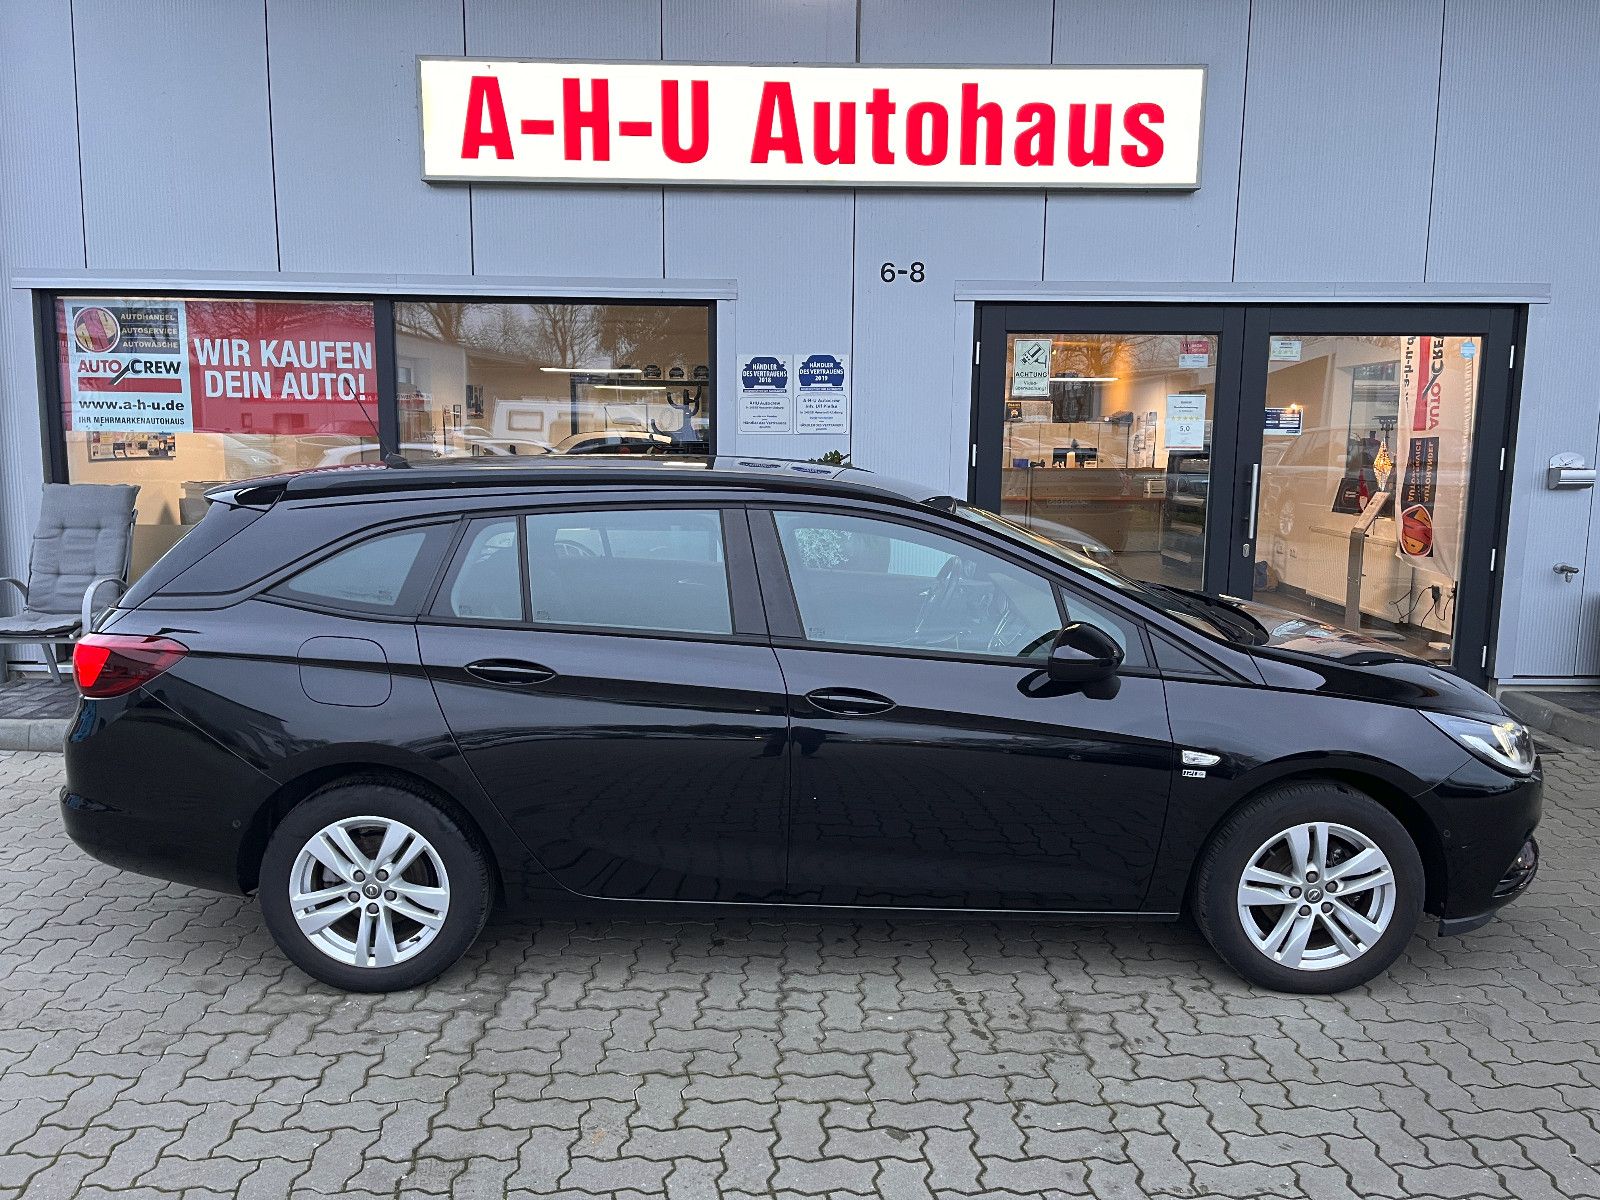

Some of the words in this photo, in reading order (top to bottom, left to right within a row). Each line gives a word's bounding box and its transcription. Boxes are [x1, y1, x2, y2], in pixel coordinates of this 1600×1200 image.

[461, 75, 709, 163] A-H-U
[750, 80, 1165, 168] Autohaus
[880, 261, 925, 283] 6-8
[120, 313, 176, 321] AUTOHANDEL
[121, 327, 178, 335] AUTOSERVICE
[193, 338, 251, 367] WIR
[259, 339, 373, 370] KAUFEN
[77, 359, 122, 374] AUTO
[129, 358, 181, 375] CREW
[752, 362, 778, 371] HÄNDLER
[753, 370, 787, 378] VERTRAUENS
[204, 370, 272, 399] DEIN
[281, 372, 367, 401] AUTO!
[78, 399, 185, 411] www.a-h-u.de
[78, 416, 92, 424] IHR
[94, 416, 185, 426] MEHRMARKENAUTOHAUS
[1179, 425, 1191, 433] 5,0
